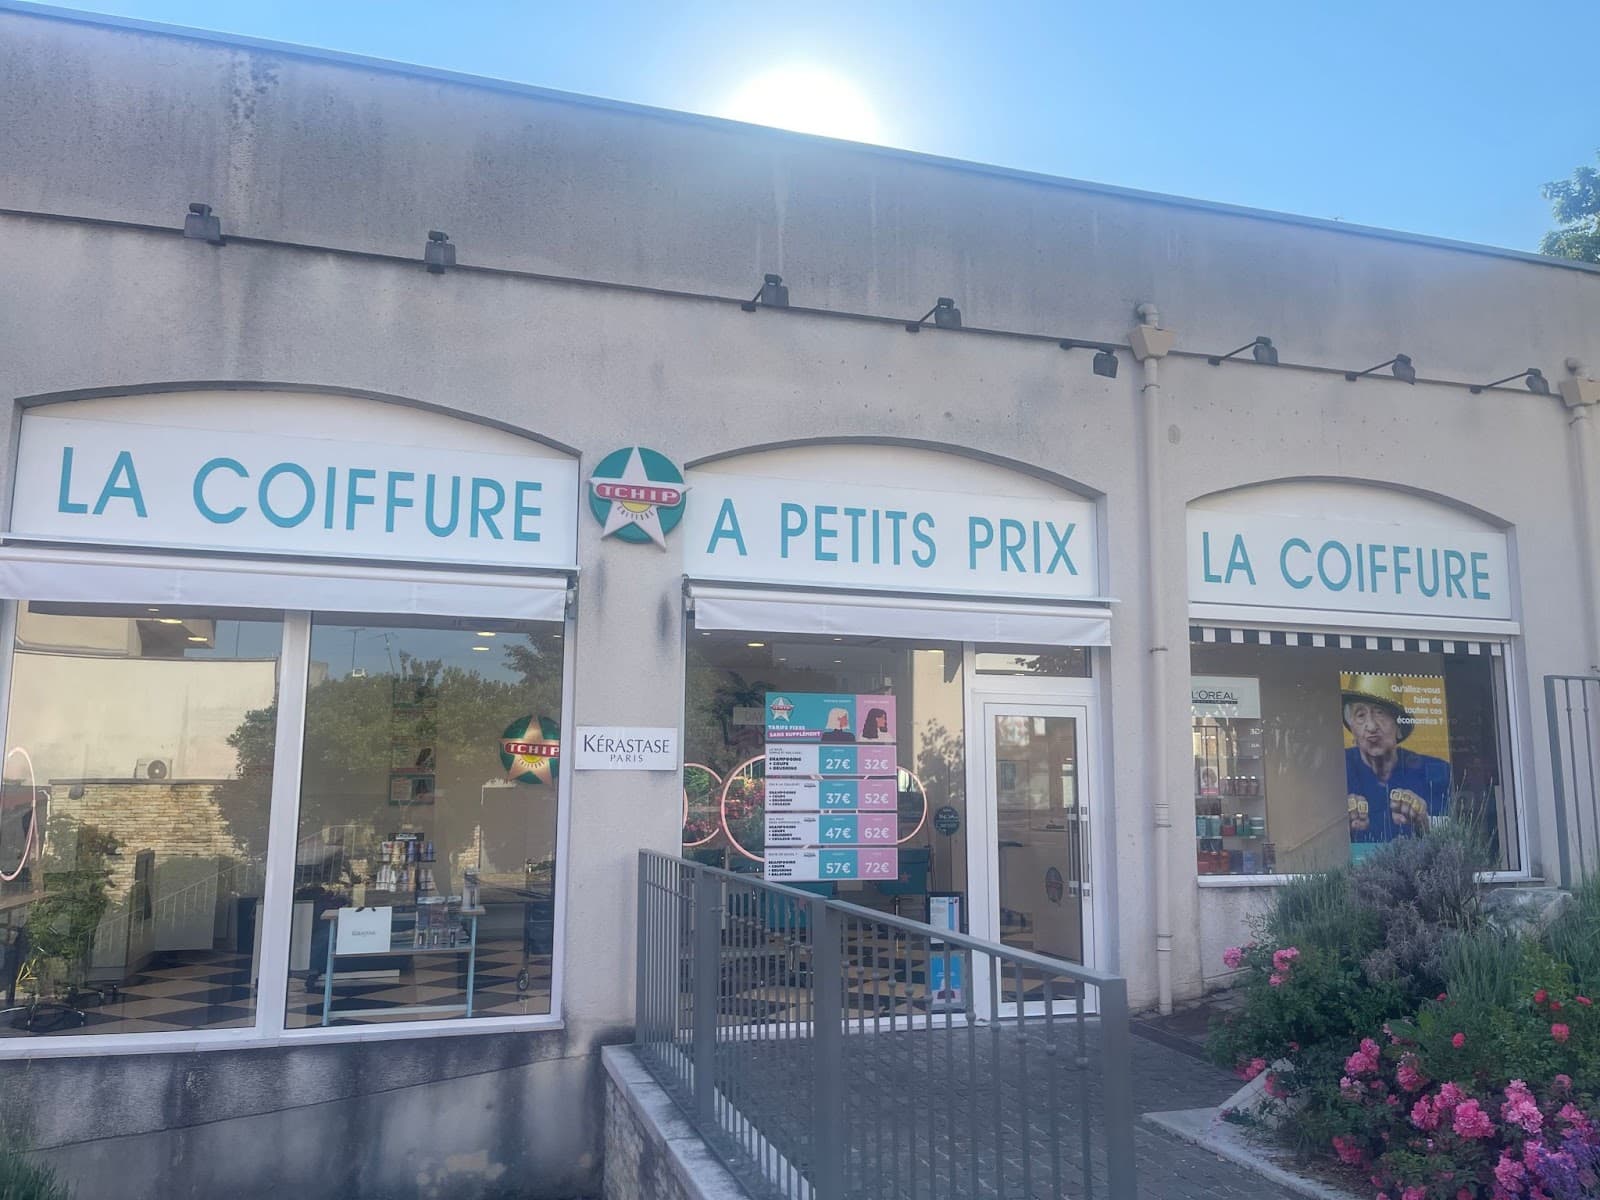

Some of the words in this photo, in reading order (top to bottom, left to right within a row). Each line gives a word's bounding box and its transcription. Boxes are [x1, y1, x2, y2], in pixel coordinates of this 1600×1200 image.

[58, 447, 148, 518] LA
[192, 457, 543, 543] COIFFURE
[602, 485, 678, 502] TCHIP
[706, 498, 747, 556] A
[780, 503, 936, 569] PETITS
[969, 516, 1078, 576] PRIX
[1202, 532, 1256, 585] LA
[1280, 538, 1491, 600] COIFFURE
[509, 743, 559, 756] TCHIP
[583, 734, 669, 753] KÉRASTASE
[610, 754, 645, 763] PARIS
[825, 759, 851, 770] 27€
[864, 759, 889, 770] 32€
[825, 793, 851, 804] 37€
[864, 793, 889, 804] 52€
[825, 827, 852, 839] 47€
[864, 827, 890, 839] 62€
[826, 862, 851, 874] 57€
[865, 862, 890, 874] 72€
